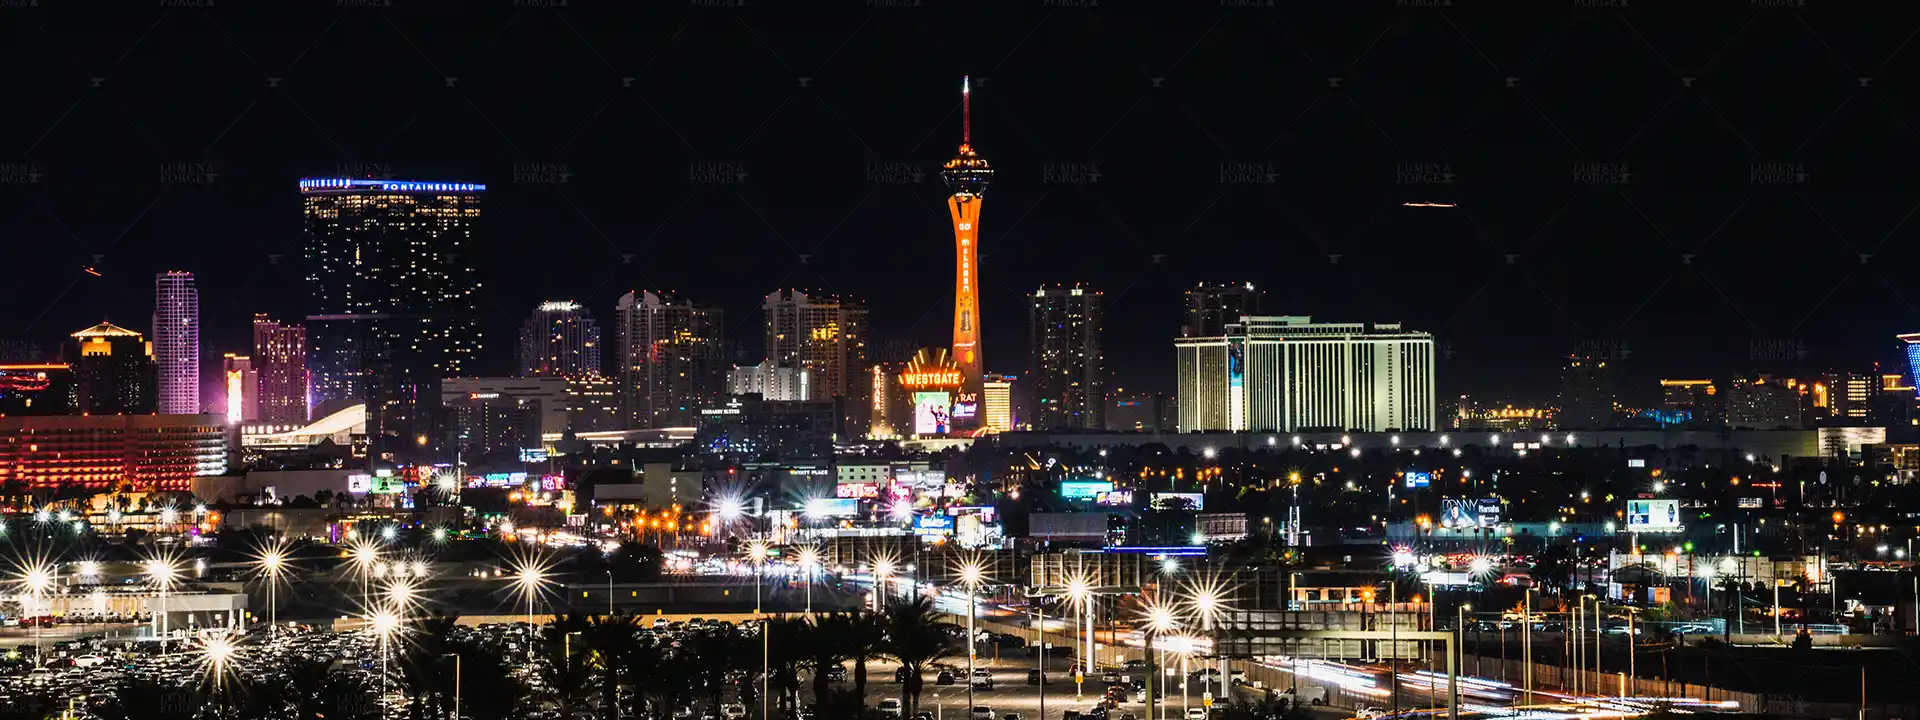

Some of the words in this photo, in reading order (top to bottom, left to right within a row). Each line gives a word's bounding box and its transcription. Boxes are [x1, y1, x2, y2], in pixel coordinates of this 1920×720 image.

[383, 183, 474, 191] FONTAINEBLEAU
[905, 373, 959, 385] WESTGATE
[873, 365, 881, 410] SAHARA
